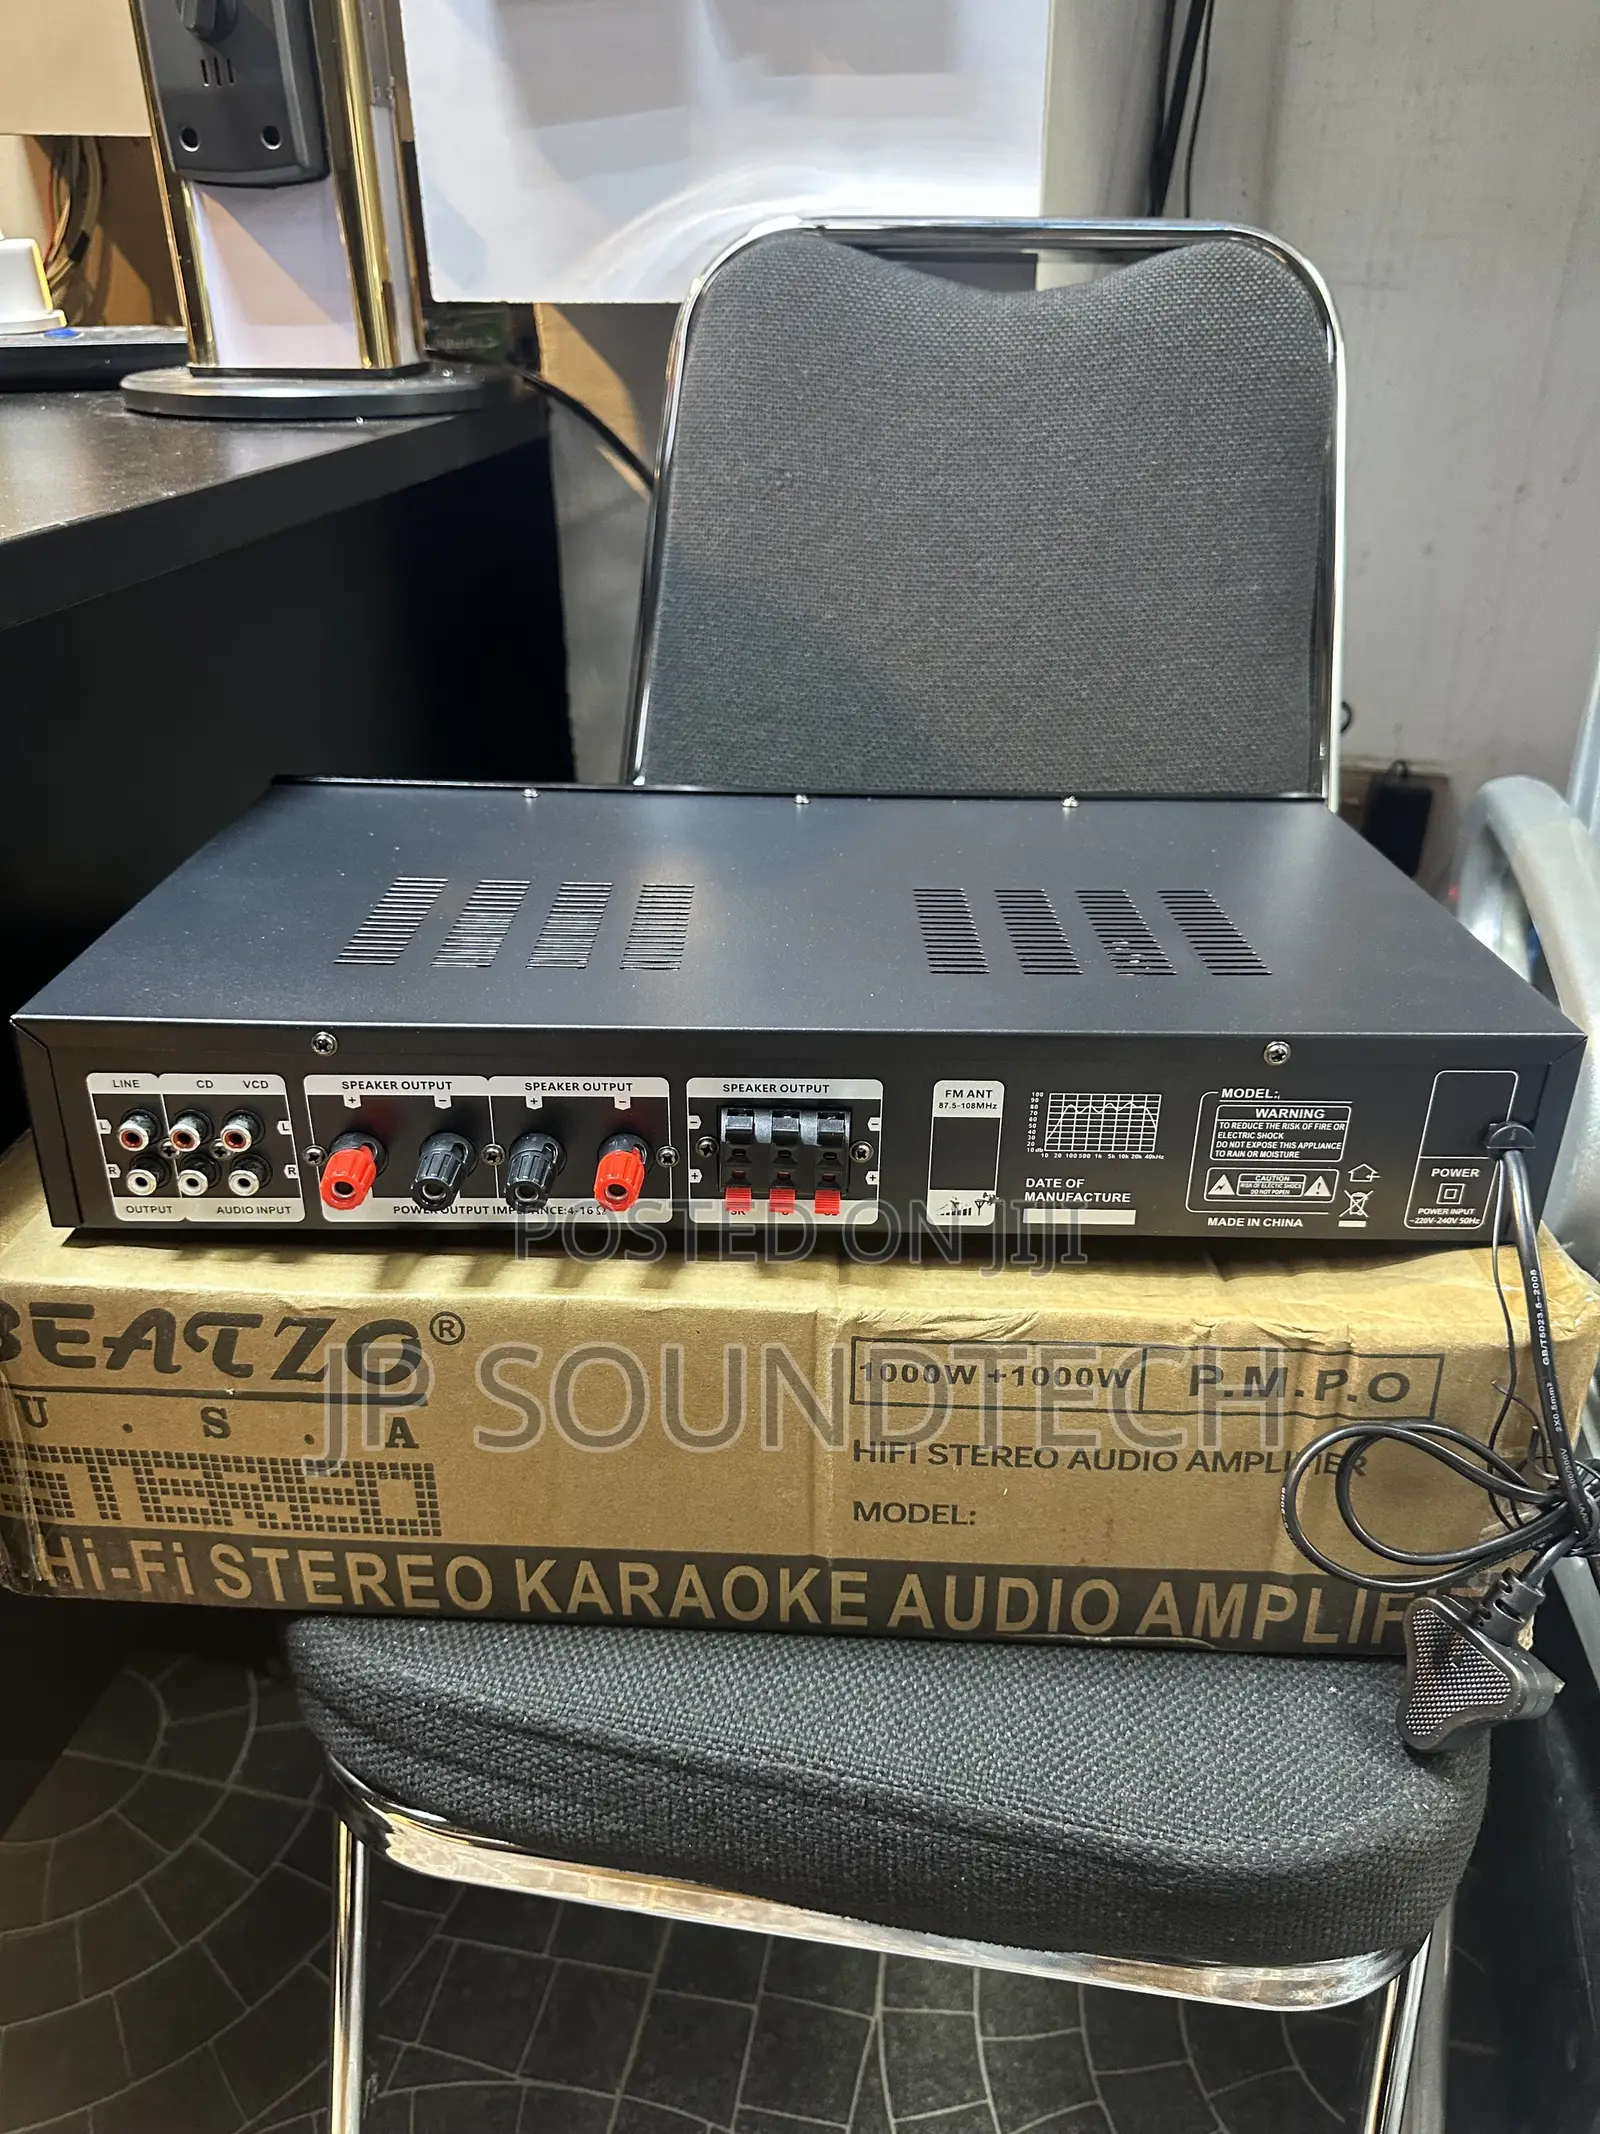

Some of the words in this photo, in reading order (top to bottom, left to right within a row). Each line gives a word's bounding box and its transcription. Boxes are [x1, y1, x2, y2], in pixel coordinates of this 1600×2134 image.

[112, 1079, 141, 1089] LINE
[196, 1079, 214, 1089] CD
[243, 1080, 269, 1089] VCD
[342, 1079, 399, 1090] SPEAKER
[401, 1079, 453, 1090] OUTPUT
[524, 1081, 580, 1092] SPEAKER
[582, 1081, 633, 1092] OUTPUT
[722, 1083, 778, 1093] SPEAKER
[779, 1083, 830, 1093] OUTPUT
[945, 1089, 965, 1099] FM
[966, 1089, 993, 1099] ANT
[938, 1101, 998, 1110] 87.5-108MHz
[1255, 1108, 1326, 1119] WARNING
[1219, 1121, 1230, 1130] TO
[1231, 1121, 1264, 1130] REDUCE
[1265, 1122, 1280, 1130] THE
[1281, 1122, 1301, 1131] RISK
[1302, 1122, 1313, 1131] OF
[1314, 1123, 1333, 1131] FIRE
[1333, 1123, 1346, 1131] OR
[1217, 1131, 1256, 1139] ELECTRIC
[1256, 1132, 1284, 1140] SHOCK
[1216, 1140, 1227, 1149] DO
[1227, 1140, 1246, 1149] NOT
[1246, 1141, 1278, 1149] EXPOSE
[1279, 1142, 1297, 1150] THIS
[1297, 1142, 1343, 1150] APPLIANCE
[1226, 1150, 1246, 1158] RAIN
[1246, 1150, 1259, 1158] OR
[1259, 1150, 1300, 1159] MOISTURE
[1431, 1167, 1481, 1178] POWER
[1026, 1177, 1063, 1189] DATE
[1065, 1177, 1085, 1189] OF
[1024, 1192, 1132, 1203] MANUFACTURE
[126, 1205, 173, 1214] OUTPUT
[216, 1205, 254, 1215] AUDIO
[256, 1205, 292, 1215] INPUT
[393, 1205, 438, 1214] POWE
[1417, 1207, 1449, 1215] POWER
[1207, 1217, 1245, 1227] MADE
[1246, 1217, 1261, 1227] IN
[1262, 1217, 1304, 1228] CHINA
[860, 1362, 978, 1385] 1000W
[1188, 1364, 1411, 1403] P.M.P.O
[853, 1439, 917, 1465] HIFI
[927, 1442, 1059, 1469] STEREO
[1066, 1447, 1178, 1473] AUDIO
[1185, 1450, 1368, 1478] AMPLIIER
[853, 1500, 977, 1526] MODEL:
[40, 1536, 195, 1596] Hi-Fi
[210, 1543, 493, 1612] STEREO
[514, 1558, 869, 1628] KARAOKE
[886, 1573, 1120, 1634] AUDIO
[1135, 1579, 1486, 1645] AMPLIF
